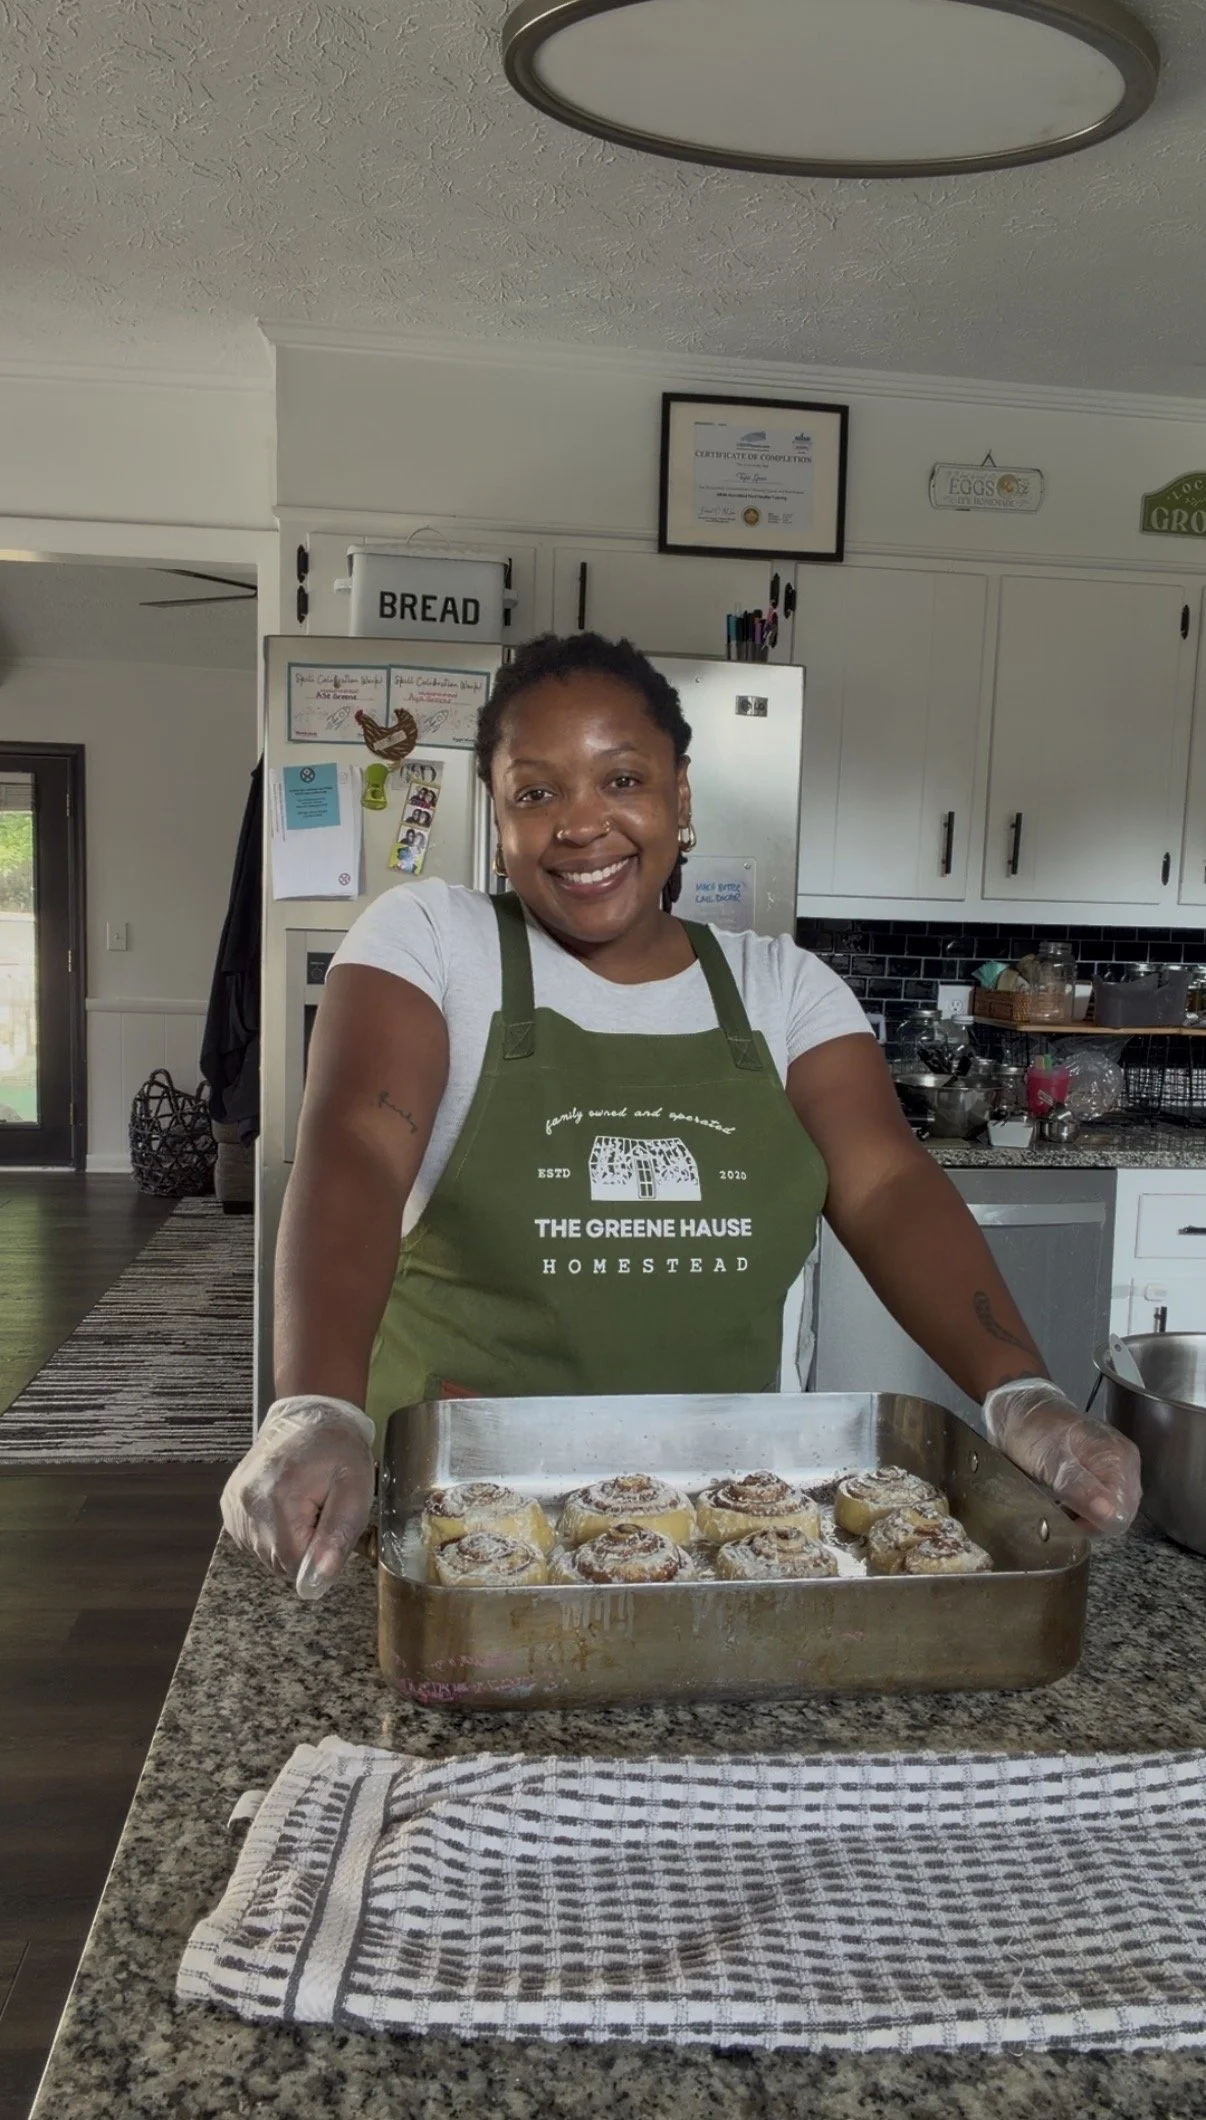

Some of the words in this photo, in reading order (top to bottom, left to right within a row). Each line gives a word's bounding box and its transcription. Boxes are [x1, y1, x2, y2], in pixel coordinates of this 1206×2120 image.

[694, 450, 746, 461] CERTIFICATE
[747, 452, 758, 461] OF
[760, 453, 812, 464] COMPLETION
[948, 477, 995, 497] EGGS
[379, 590, 480, 626] BREAD
[545, 1107, 583, 1136] family
[588, 1107, 628, 1118] owned
[634, 1107, 663, 1118] and
[668, 1110, 736, 1135] operated
[537, 1168, 571, 1179] ESTD
[719, 1170, 747, 1181] 2020
[534, 1218, 581, 1238] THE
[586, 1218, 676, 1238] GREENE
[680, 1218, 753, 1238] HAUSE
[542, 1257, 749, 1275] HOMESTEAD
